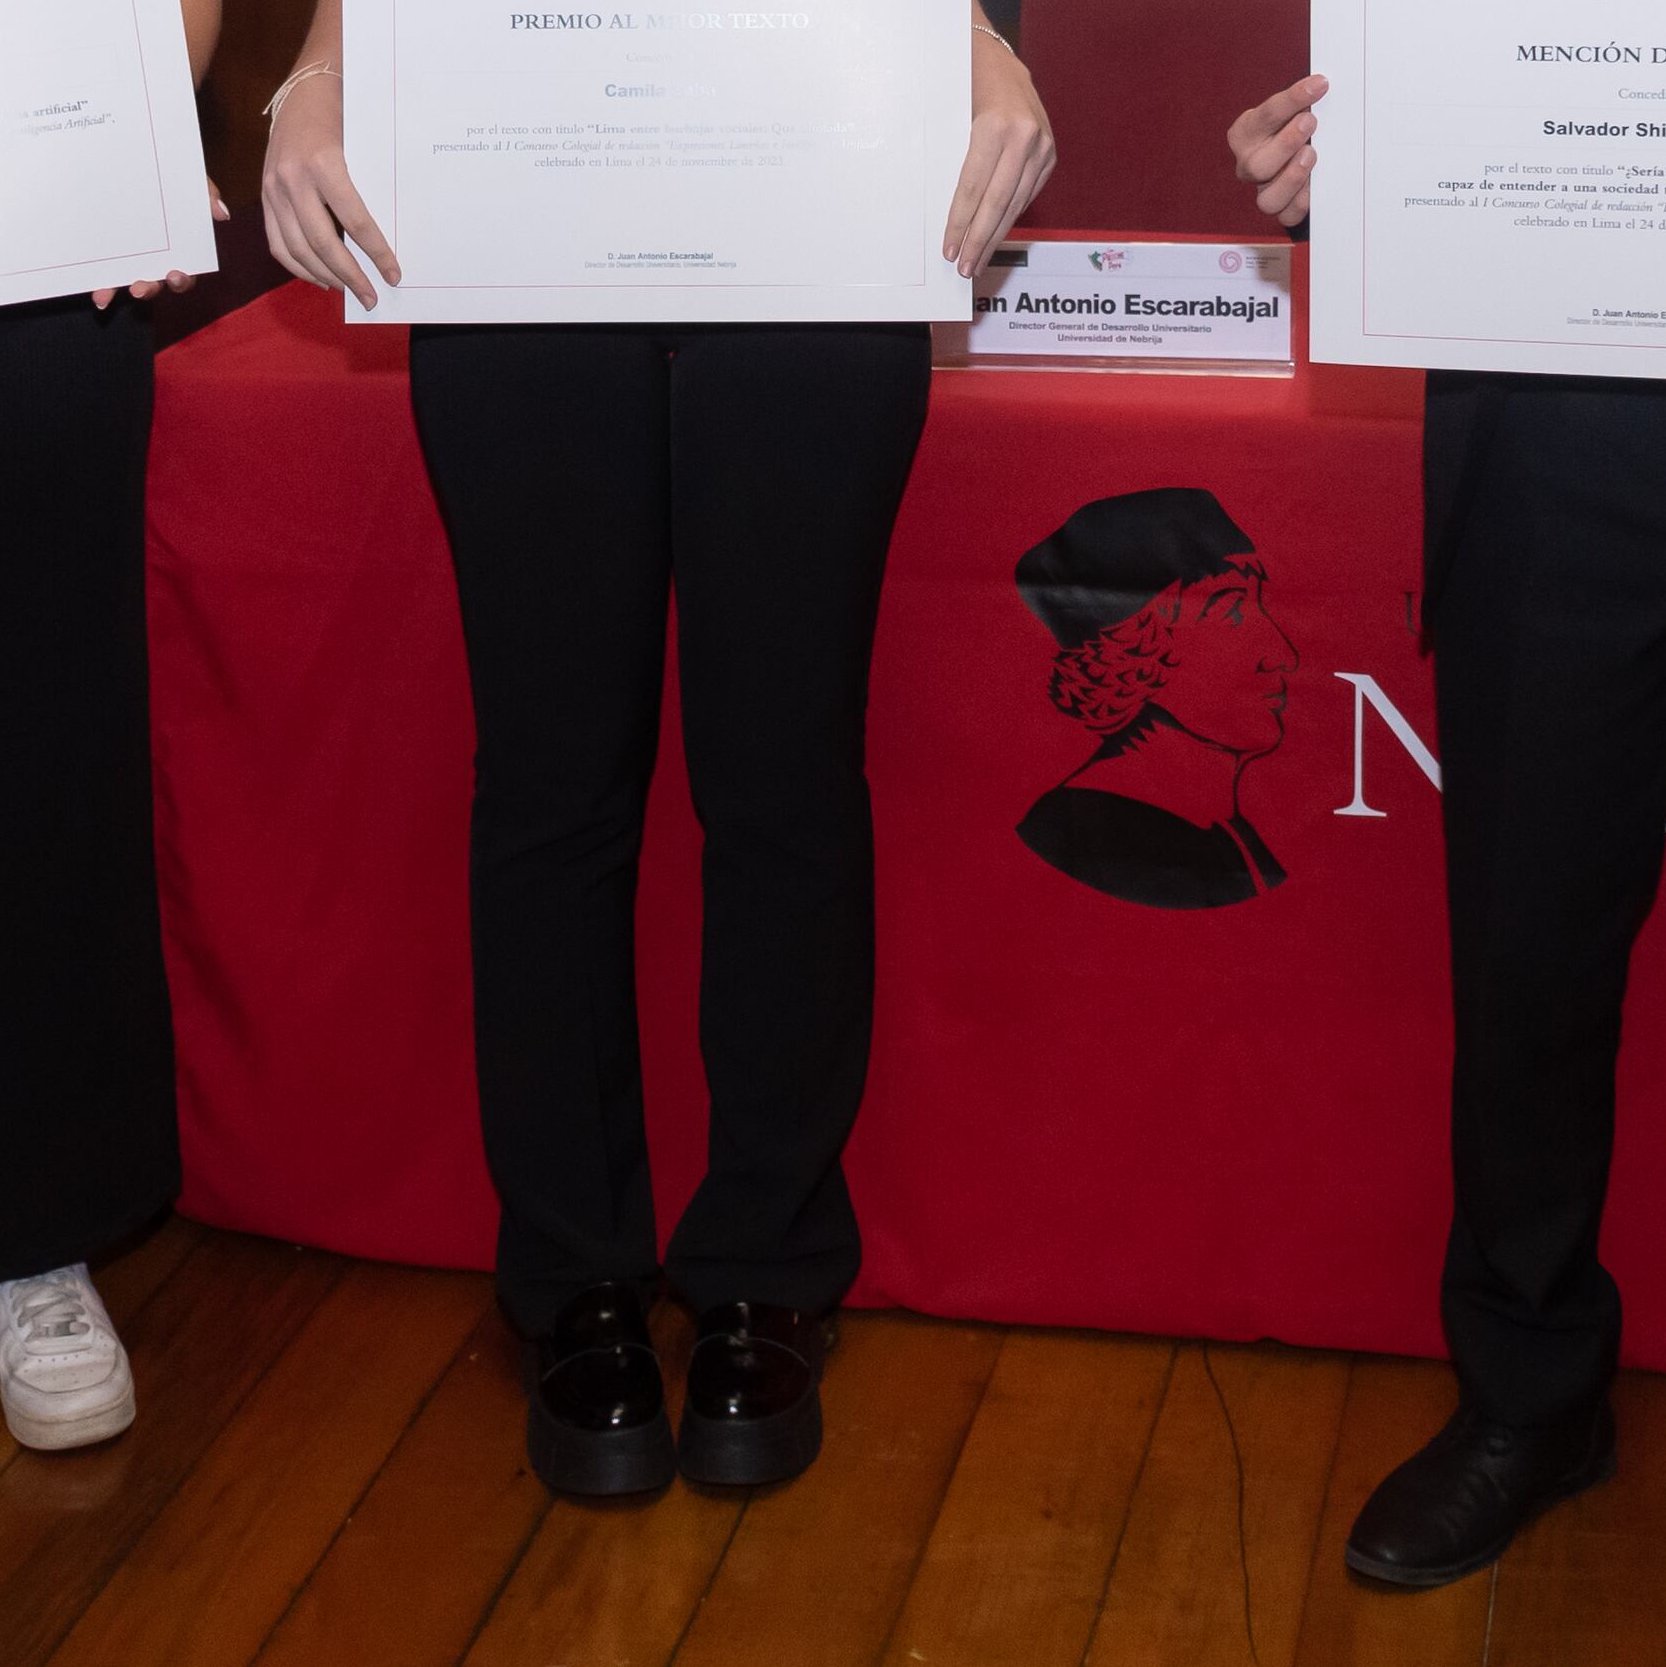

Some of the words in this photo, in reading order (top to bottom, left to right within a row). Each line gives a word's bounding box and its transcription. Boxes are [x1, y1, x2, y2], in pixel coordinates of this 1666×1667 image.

[510, 13, 602, 30] PREMIO
[609, 13, 638, 30] AL
[729, 12, 810, 30] TEXTO
[1516, 41, 1642, 64] MENCIÓN
[604, 84, 667, 98] Camila
[467, 126, 485, 137] por
[488, 124, 498, 135] el
[501, 126, 529, 135] texto
[532, 127, 552, 135] con
[1543, 120, 1630, 137] Salvador
[433, 141, 490, 154] presentado
[493, 140, 502, 151] al
[514, 141, 559, 152] Concurso
[534, 157, 585, 167] celebrado
[606, 158, 632, 167] Lima
[636, 157, 645, 167] el
[648, 157, 661, 167] 24
[665, 156, 678, 166] de
[1484, 164, 1505, 176] por
[1508, 163, 1518, 174] el
[1522, 165, 1552, 175] texto
[1556, 167, 1578, 175] con
[1438, 181, 1475, 192] capaz
[1479, 179, 1494, 190] de
[1499, 180, 1555, 192] entender
[1573, 184, 1597, 193] una
[1602, 182, 1658, 195] sociedad
[1404, 196, 1466, 208] presentado
[1468, 196, 1479, 207] al
[1483, 198, 1489, 207] I
[1492, 198, 1540, 210] Concurso
[1544, 199, 1588, 213] Colegial
[1591, 200, 1604, 211] de
[1607, 200, 1653, 213] redacción
[1514, 216, 1569, 228] celebrado
[1592, 218, 1621, 229] Lima
[1625, 218, 1635, 230] el
[1639, 219, 1654, 230] 24
[607, 252, 616, 260] D.
[617, 252, 636, 260] Juan
[638, 252, 668, 260] Antonio
[669, 252, 714, 261] Escarabajal
[1015, 292, 1117, 316] Antonio
[1124, 293, 1279, 323] Escarabajal
[1592, 308, 1601, 317] D.
[1603, 309, 1623, 318] Juan
[1625, 310, 1659, 320] Antonio
[1008, 321, 1047, 332] Director
[1049, 322, 1085, 332] General
[1087, 322, 1099, 332] de
[1101, 323, 1150, 333] Desarrollo
[1152, 323, 1212, 334] Universitario
[1057, 334, 1113, 343] Universidad
[1114, 334, 1127, 344] de
[1129, 334, 1163, 345] Nebrija
